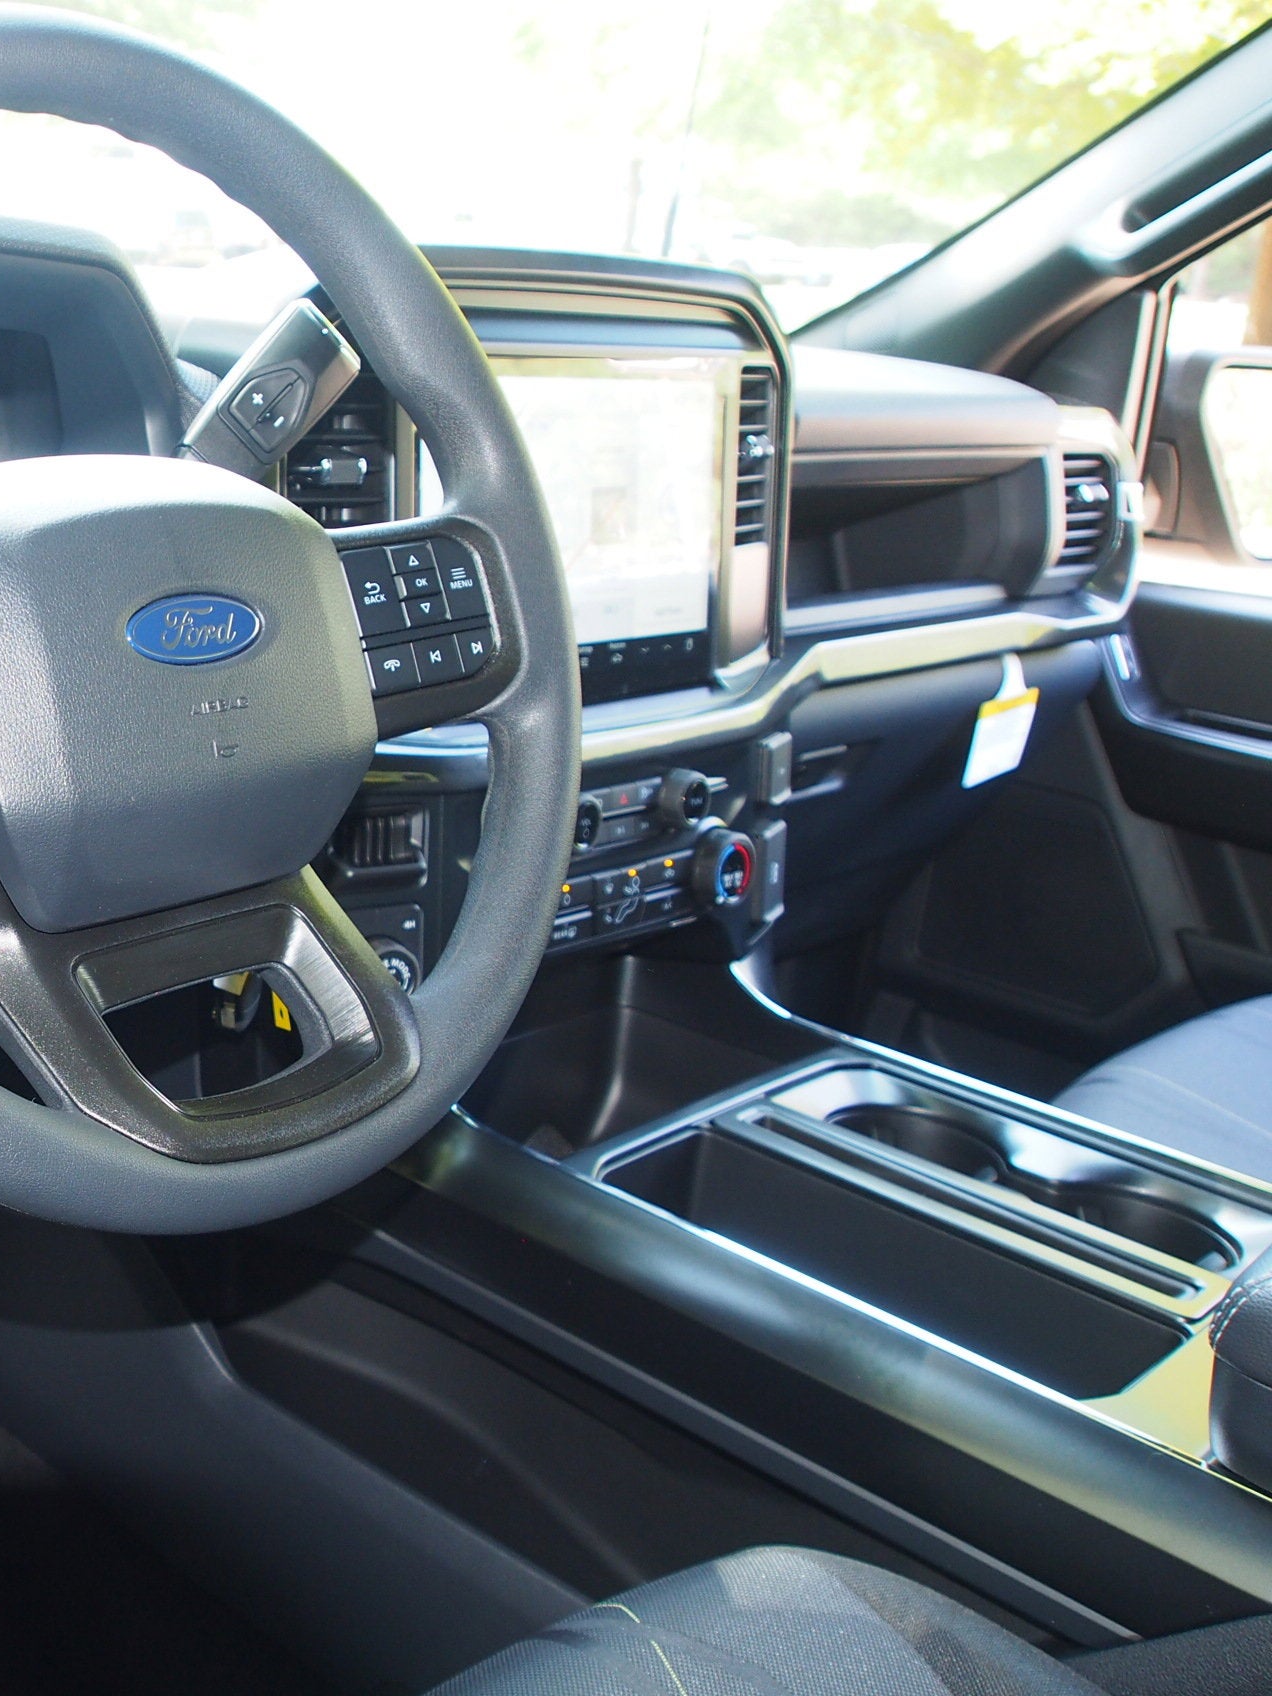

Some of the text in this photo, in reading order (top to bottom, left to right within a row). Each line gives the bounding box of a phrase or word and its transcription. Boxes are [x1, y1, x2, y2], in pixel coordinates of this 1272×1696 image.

[415, 578, 428, 587] OK
[449, 579, 473, 589] MENU
[364, 594, 386, 605] BACK
[161, 606, 236, 650] Ford
